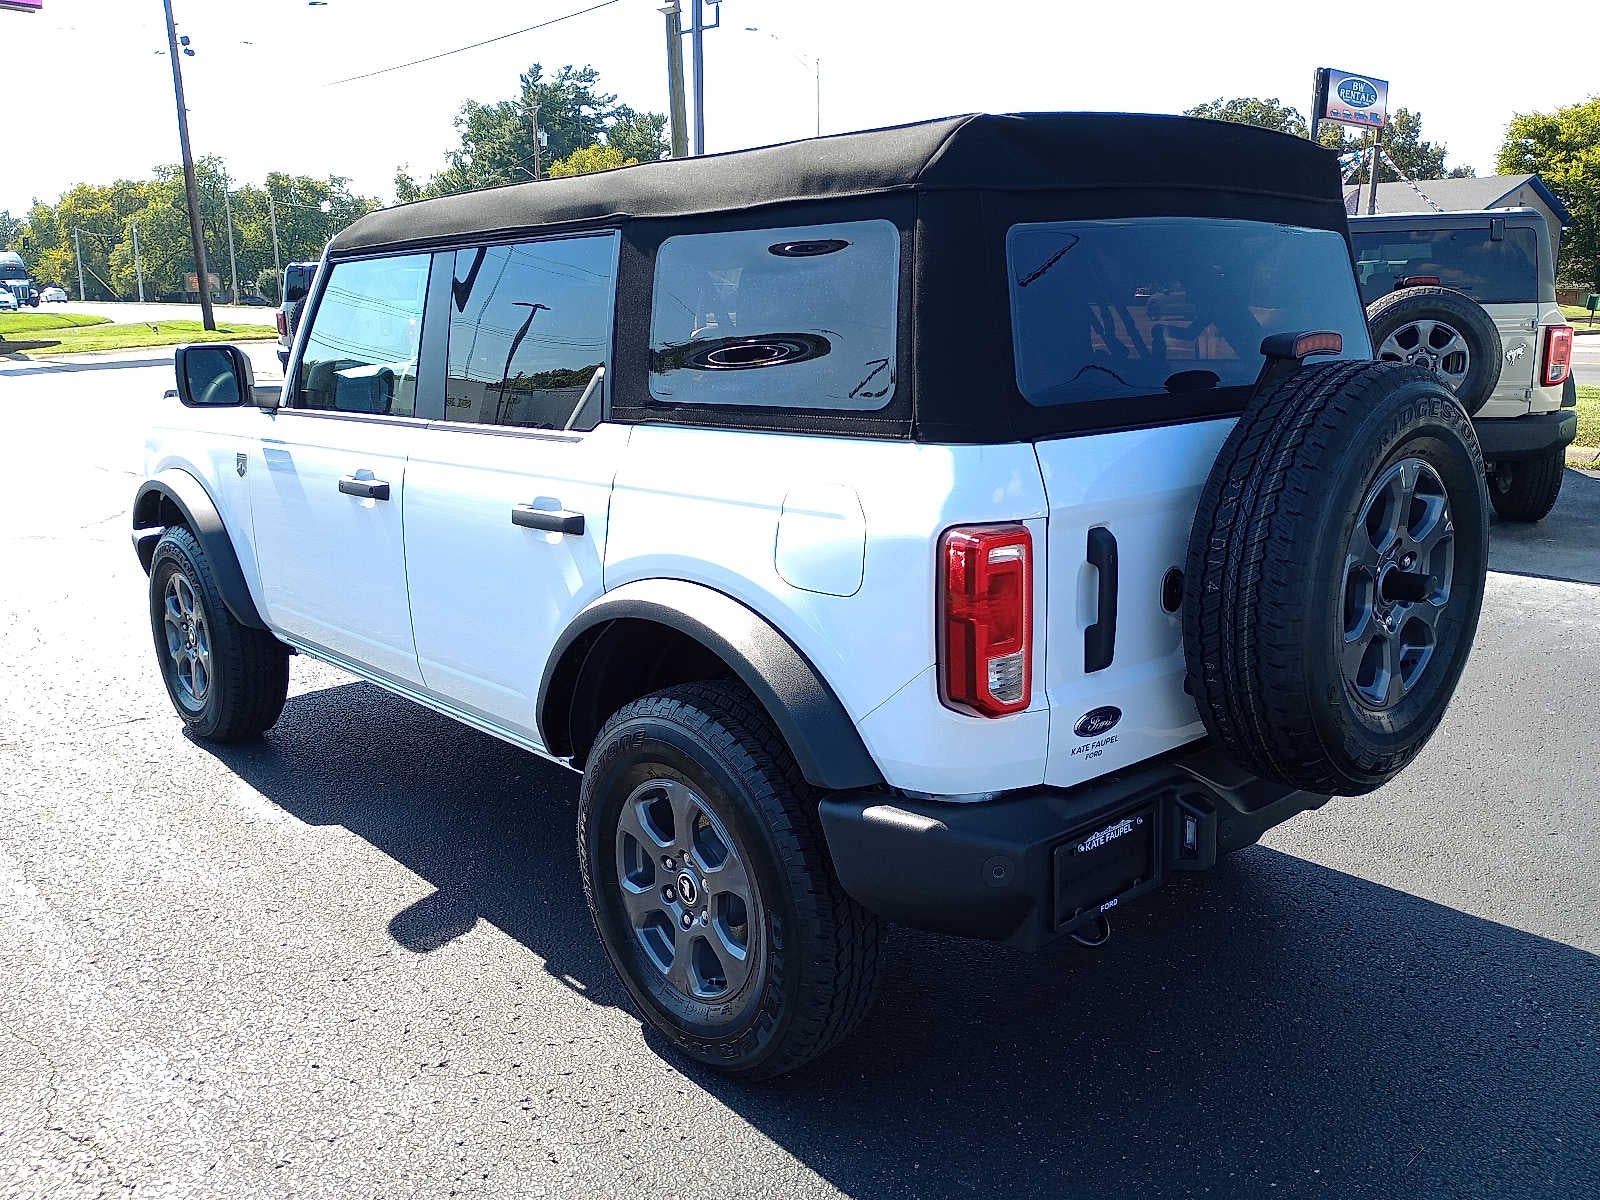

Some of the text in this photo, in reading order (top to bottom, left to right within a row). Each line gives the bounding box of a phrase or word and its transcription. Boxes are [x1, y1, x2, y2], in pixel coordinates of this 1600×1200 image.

[1352, 81, 1366, 92] BW
[1340, 88, 1376, 103] RENTALS
[1071, 735, 1119, 756] KATE FAUPEL
[1085, 749, 1103, 760] FORD
[1085, 824, 1133, 852] KATE FAUPEL
[1100, 898, 1118, 913] FORD
